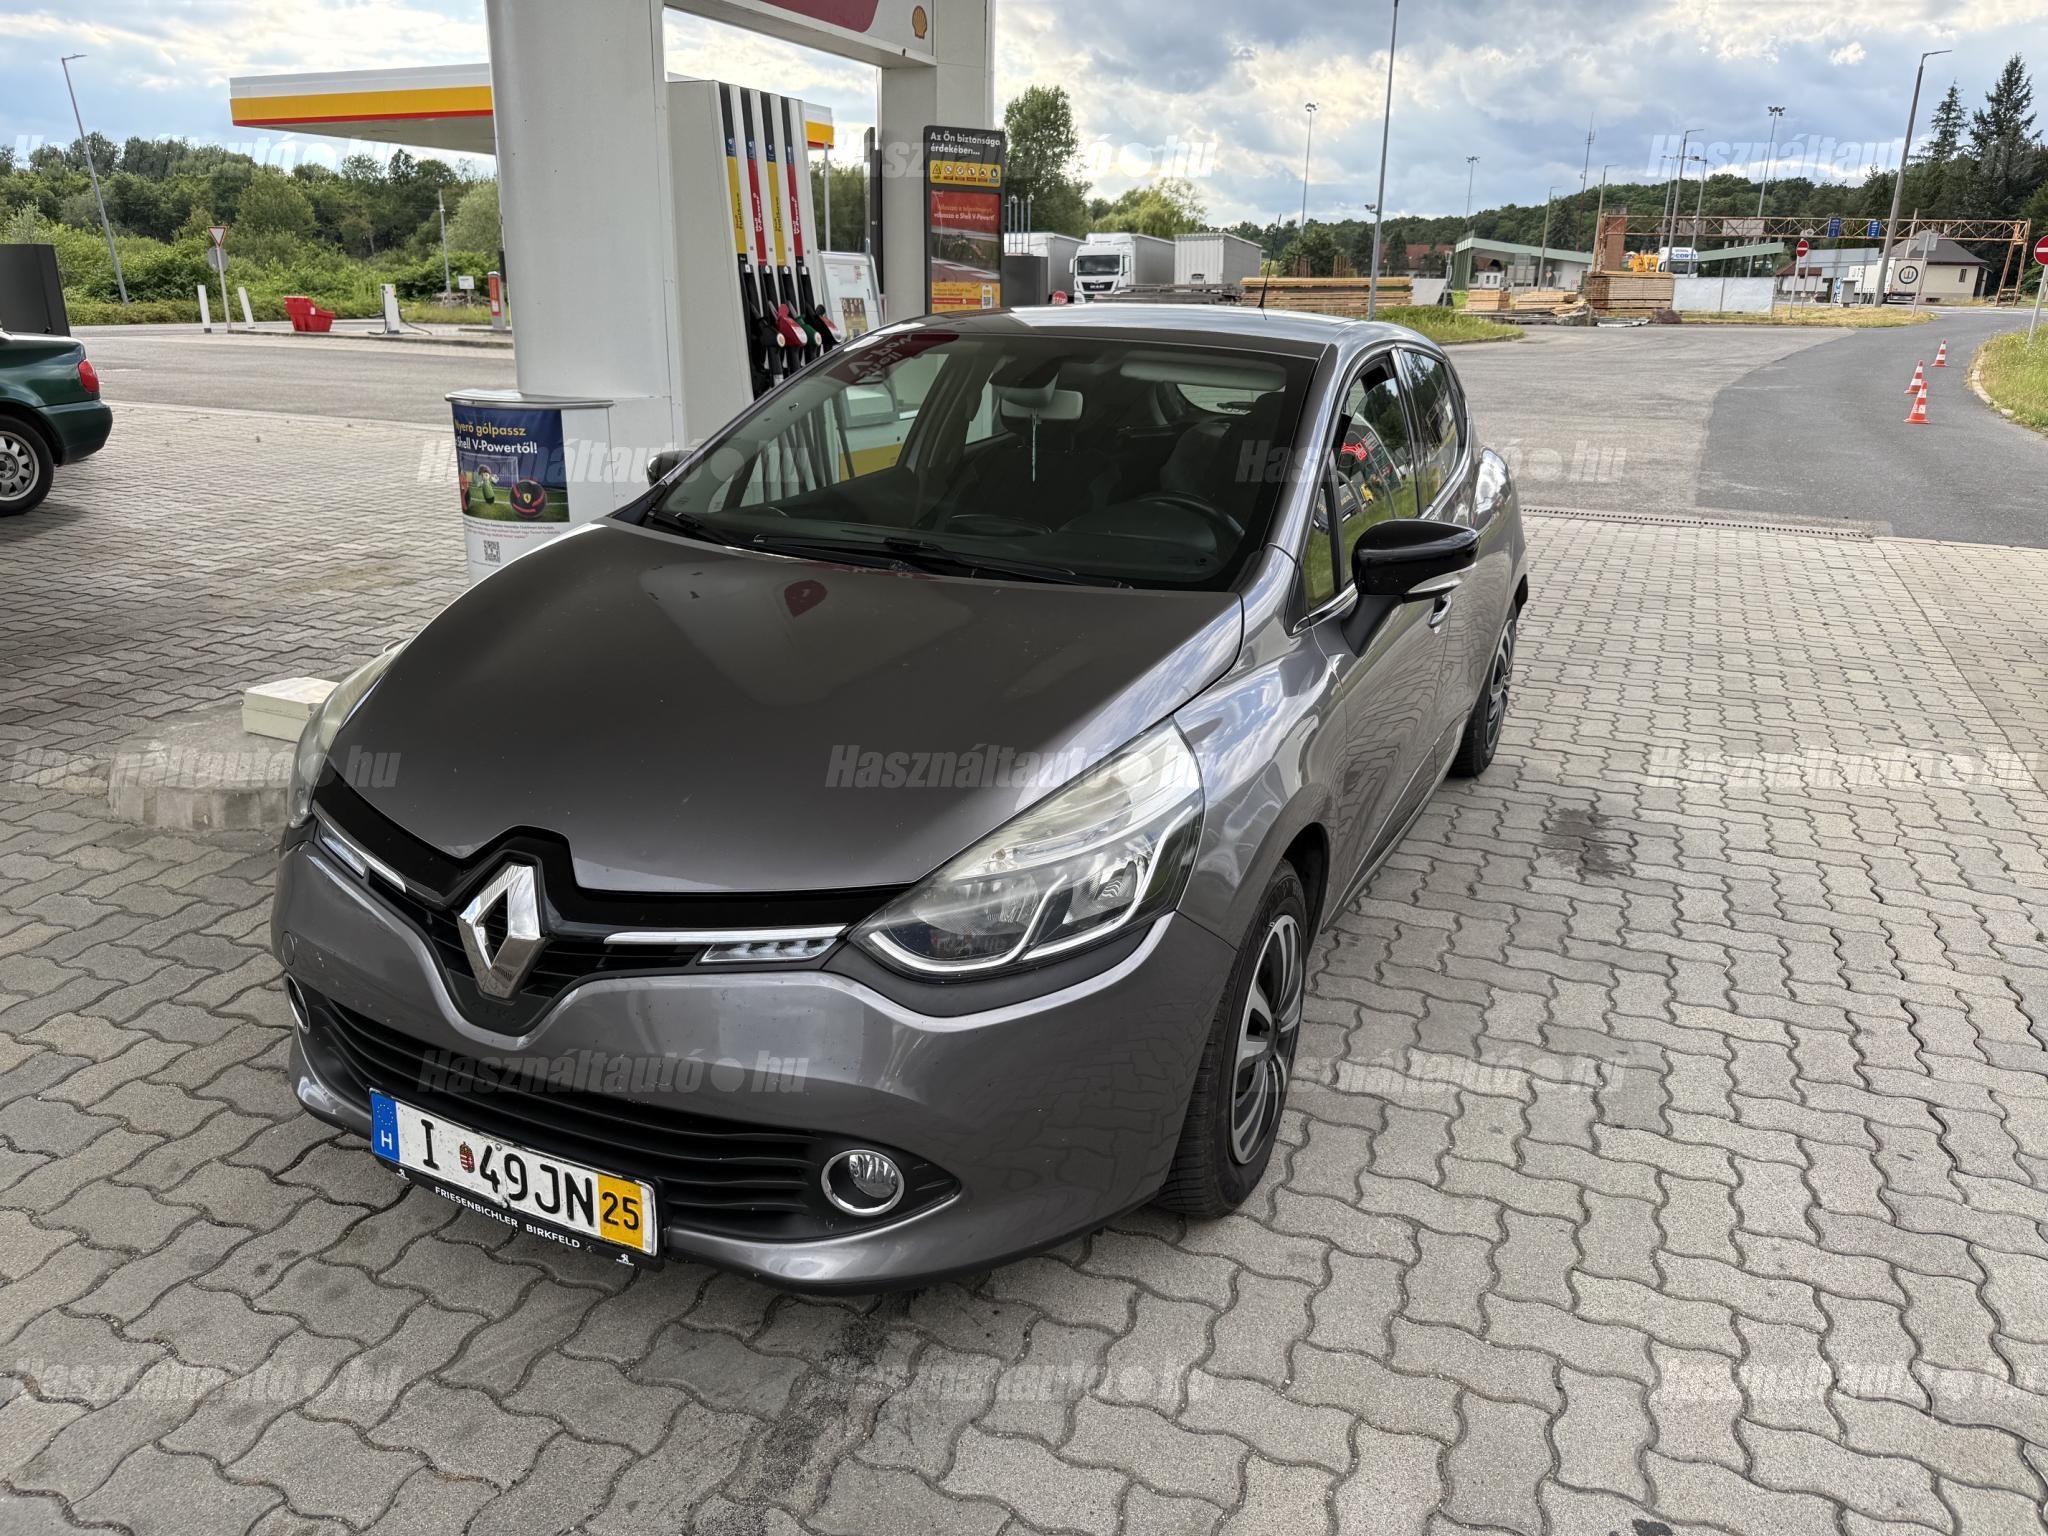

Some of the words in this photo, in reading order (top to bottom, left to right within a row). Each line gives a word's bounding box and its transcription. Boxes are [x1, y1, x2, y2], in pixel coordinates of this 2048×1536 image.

[930, 131, 941, 141] Az
[943, 130, 955, 141] Ön
[957, 132, 1001, 148] biztonsága
[930, 142, 980, 155] érdekében...
[476, 422, 527, 438] gólpassz
[472, 439, 538, 454] V-Powertől!
[380, 1129, 393, 1151] H
[435, 1186, 518, 1228] FRIESENBICHLER
[525, 1223, 581, 1249] BIRKFELD
[601, 1190, 640, 1231] 25
